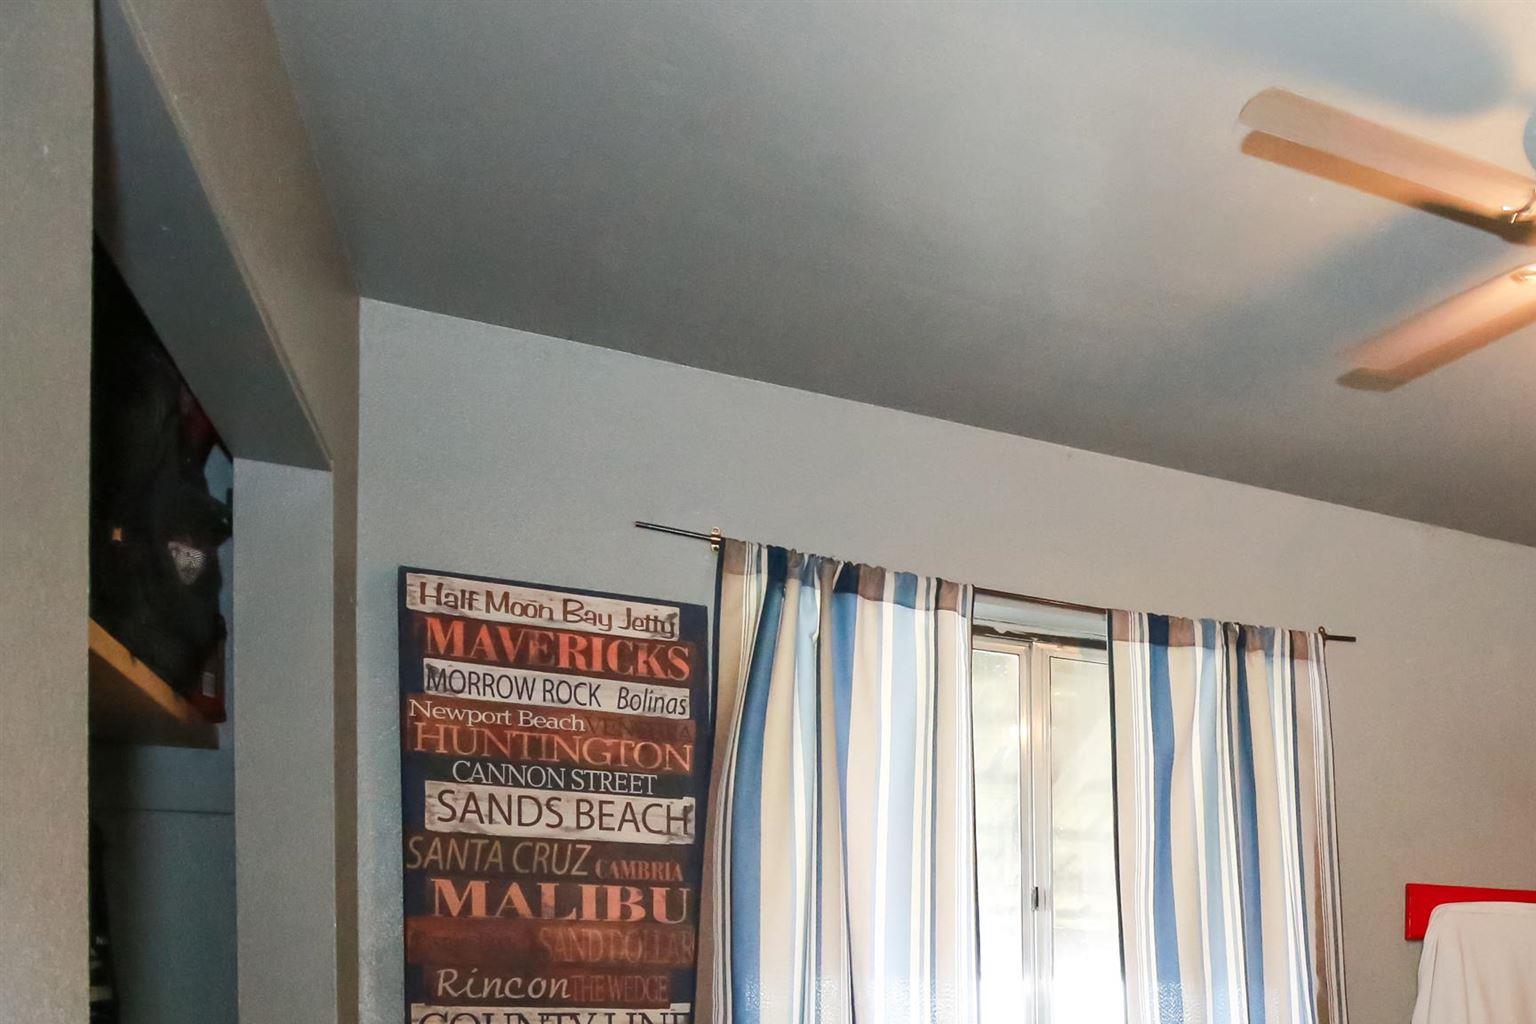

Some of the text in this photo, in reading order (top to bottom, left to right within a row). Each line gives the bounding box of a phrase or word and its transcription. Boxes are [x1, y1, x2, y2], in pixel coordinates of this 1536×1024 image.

[419, 581, 676, 638] Half Moon Bay Jetty
[424, 617, 691, 681] MAVERICKS
[425, 666, 687, 716] MORROW ROCK Bolinas
[409, 699, 586, 733] Newport Beach
[413, 722, 693, 773] HUNTINGTON
[452, 760, 658, 795] CANNON STREET
[437, 789, 689, 835] SANDS BEACH
[407, 836, 685, 882] SANTA CRUZ CAMBRIA
[431, 879, 692, 924] MALIBU
[437, 968, 570, 999] Rincon
